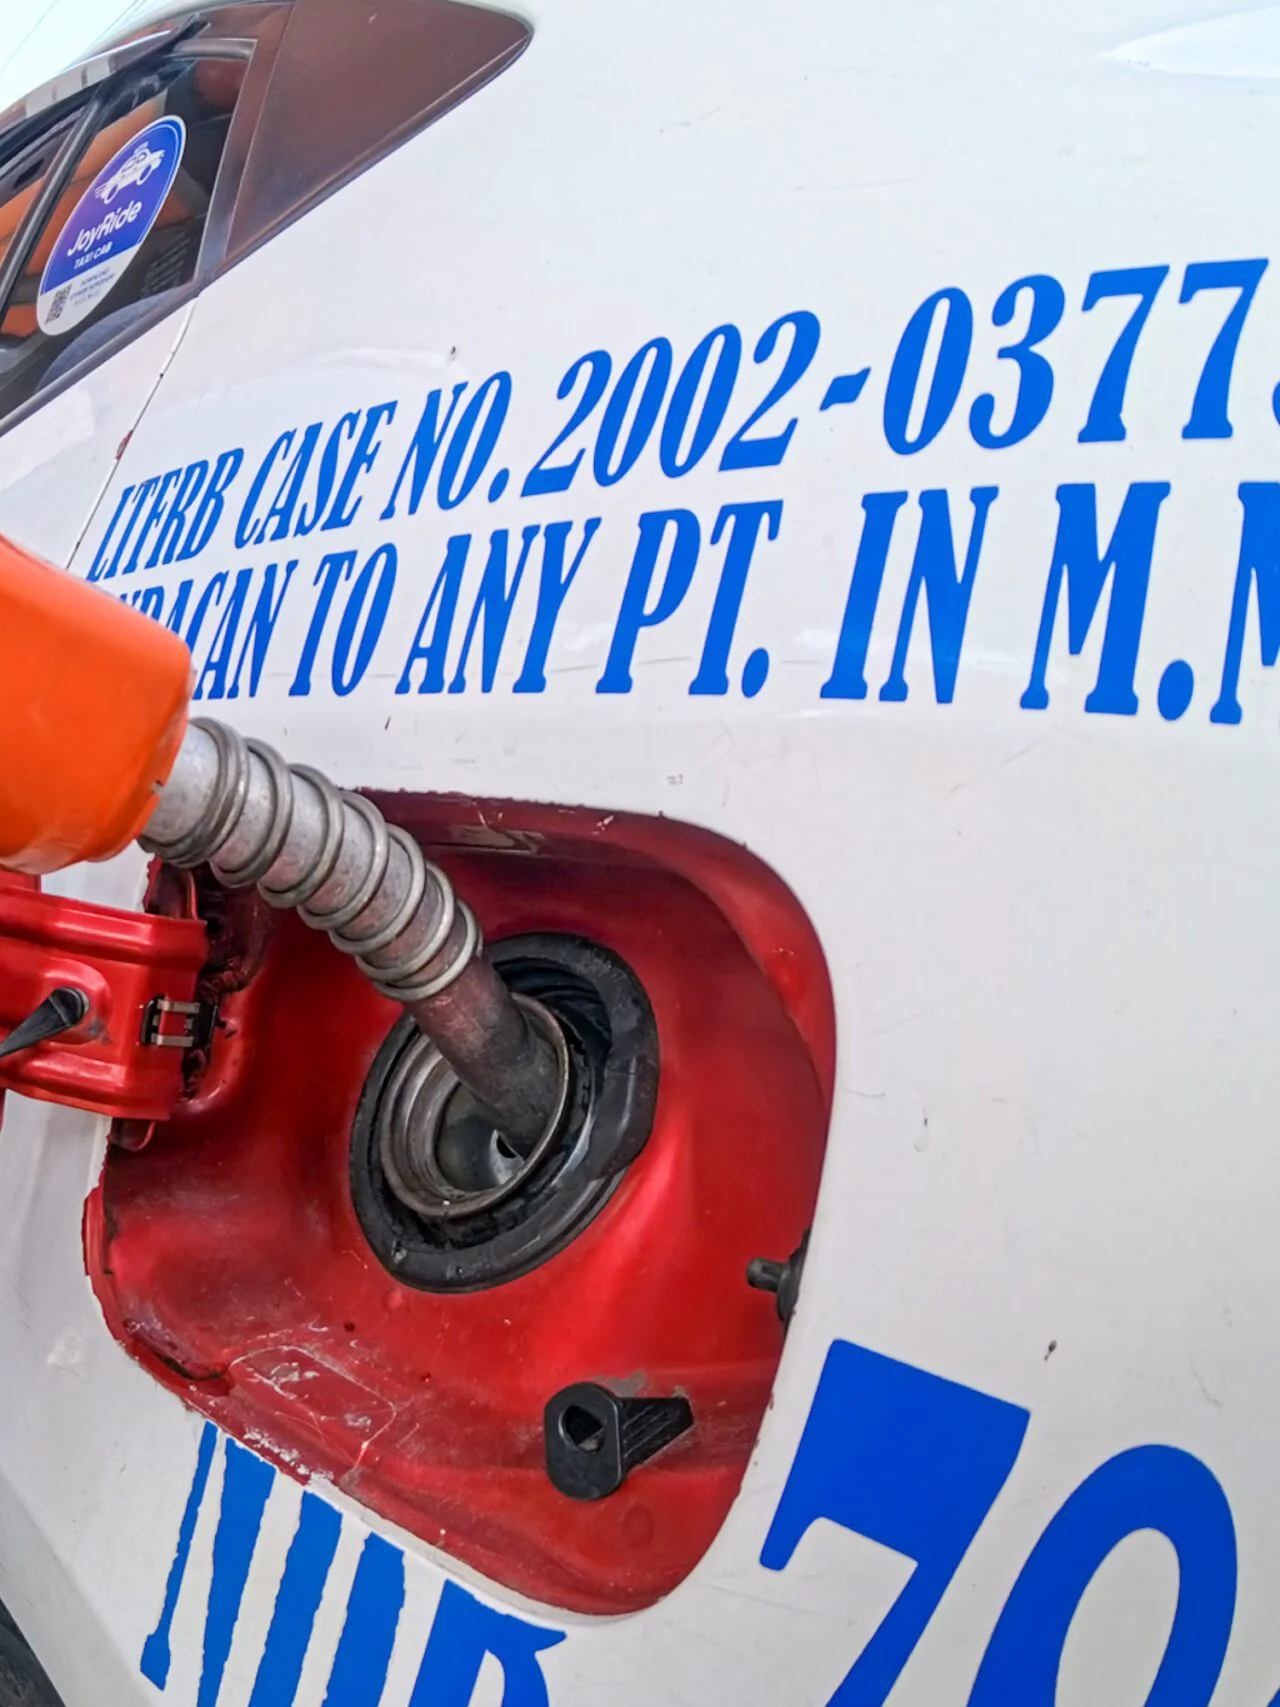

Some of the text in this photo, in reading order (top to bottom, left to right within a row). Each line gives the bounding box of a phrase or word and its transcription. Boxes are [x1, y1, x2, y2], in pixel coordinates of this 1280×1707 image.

[67, 200, 142, 257] JoyRide
[73, 240, 113, 270] TAXI CAB
[87, 258, 1280, 582] LTFRB CASE NO. 2002-0377
[288, 543, 399, 697] TO
[395, 517, 602, 695] ANY
[595, 499, 784, 698] PT.
[820, 486, 999, 704] IN
